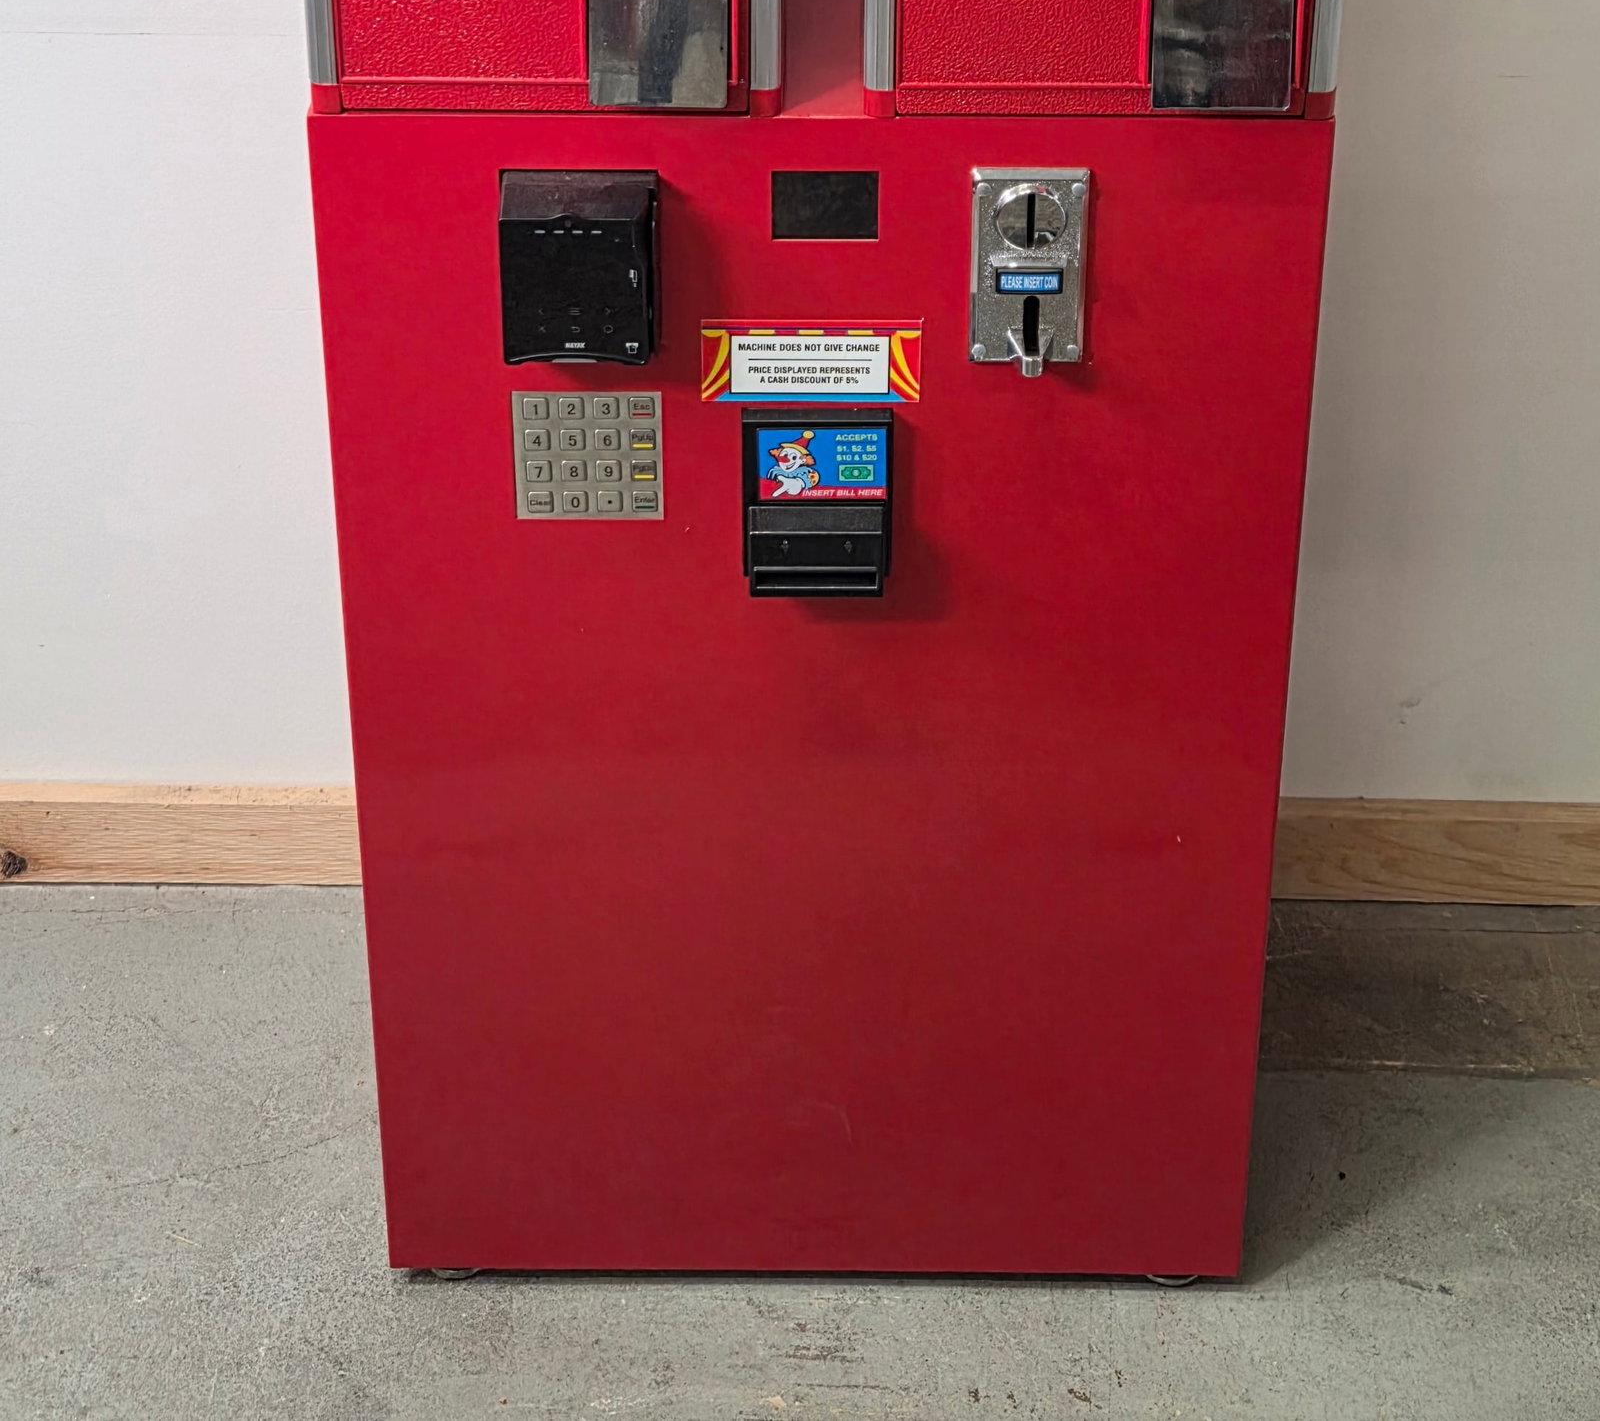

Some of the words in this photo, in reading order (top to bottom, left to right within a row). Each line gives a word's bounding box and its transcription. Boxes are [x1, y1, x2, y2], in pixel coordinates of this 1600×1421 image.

[1001, 276, 1022, 288] PLEASE
[1024, 276, 1043, 288] INSERT
[1045, 276, 1058, 288] COIN
[738, 343, 777, 352] MACHINE
[780, 343, 802, 352] DOES
[805, 343, 821, 352] NOT
[824, 344, 843, 352] GIVE
[846, 344, 880, 352] CHANGE
[749, 366, 771, 374] PRICE
[774, 366, 817, 374] DISPLAYED
[820, 366, 870, 375] REPRESENTS
[768, 376, 789, 384] CASH
[791, 376, 831, 384] DISCOUNT
[833, 376, 844, 384] OF
[846, 376, 859, 384] 5%
[533, 404, 538, 415] 1
[567, 403, 576, 415] 2
[602, 403, 610, 415] 3
[532, 435, 541, 446] 4
[568, 435, 577, 446] 5
[603, 435, 612, 446] 6
[534, 466, 542, 478] 7
[570, 466, 578, 477] 8
[604, 466, 613, 477] 9
[802, 489, 835, 497] INSERT
[571, 497, 579, 508] 0
